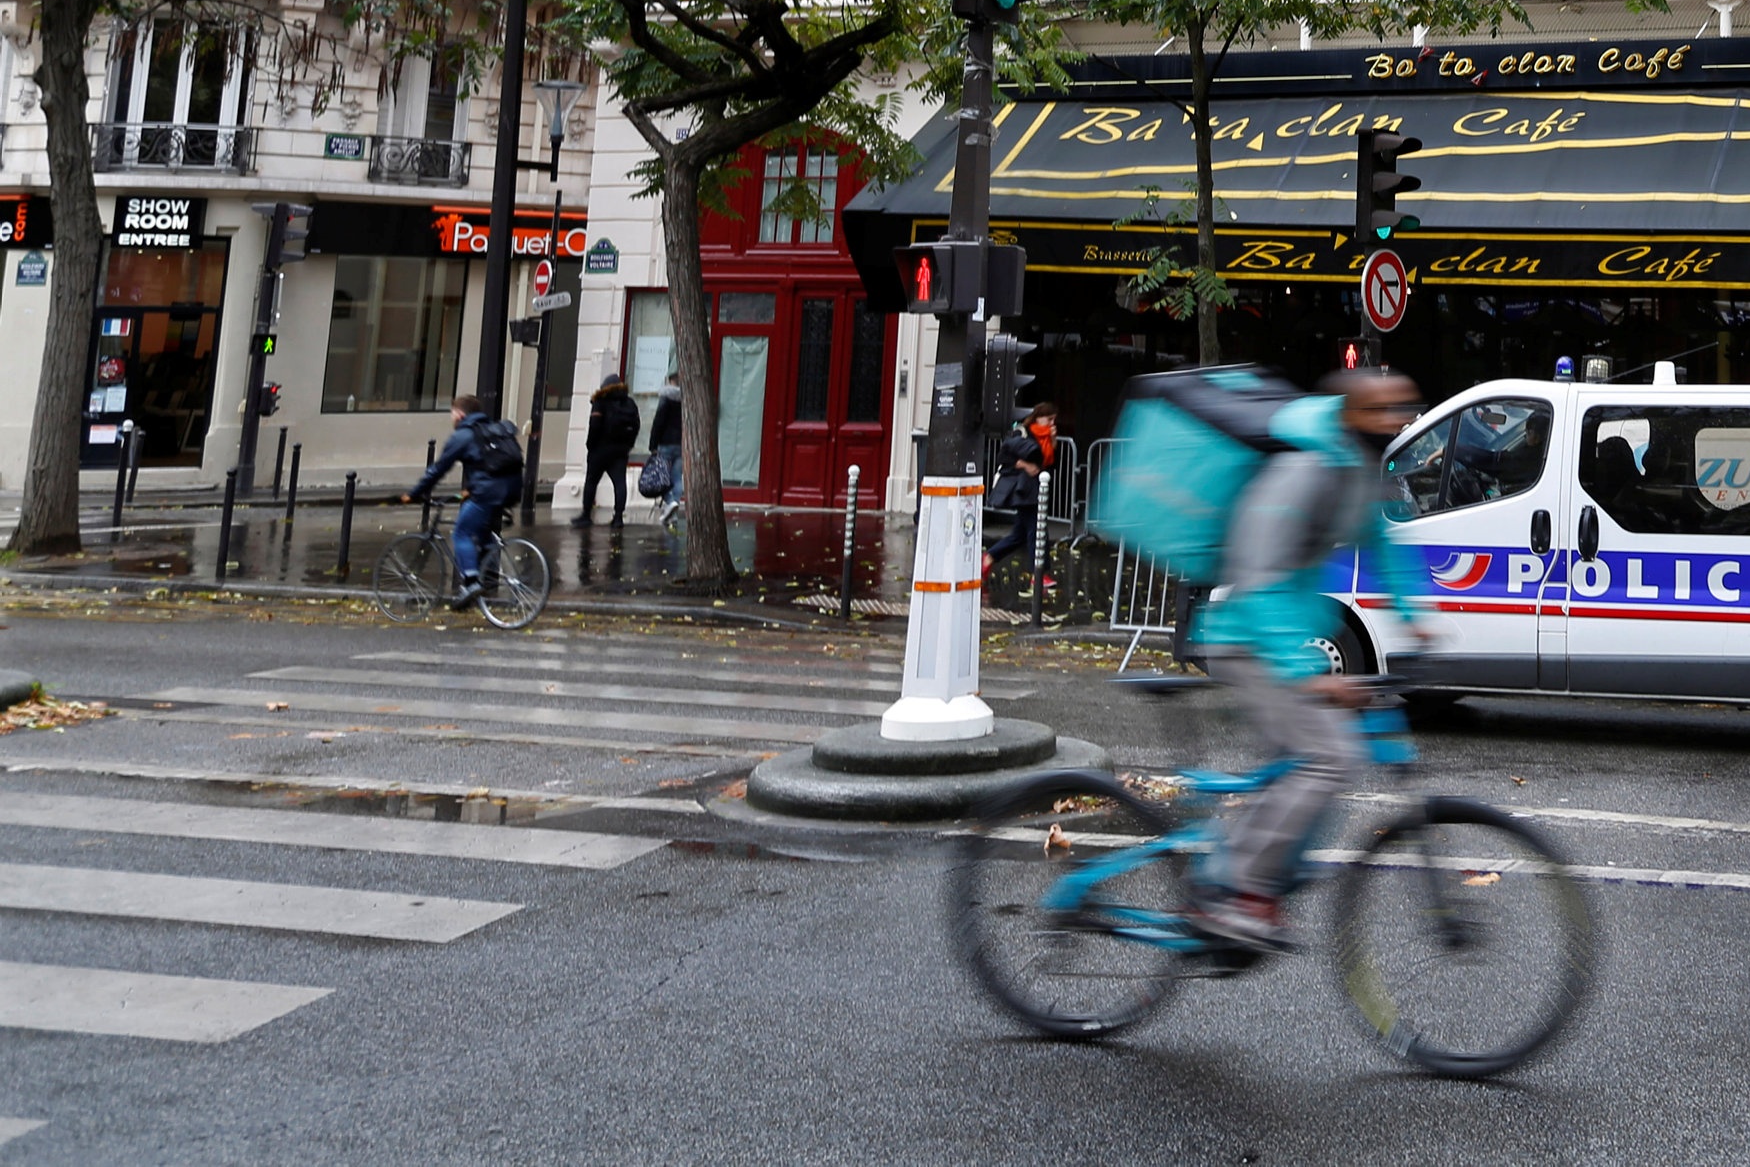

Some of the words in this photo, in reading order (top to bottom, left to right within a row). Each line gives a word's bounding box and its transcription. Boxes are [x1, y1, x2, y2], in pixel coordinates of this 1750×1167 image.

[1598, 44, 1691, 78] Café
[1452, 108, 1588, 142] Café
[14, 202, 28, 242] com
[124, 214, 189, 230] ROOM
[128, 198, 190, 214] SHOW
[118, 233, 190, 246] ENTREE
[1598, 246, 1722, 282] Café
